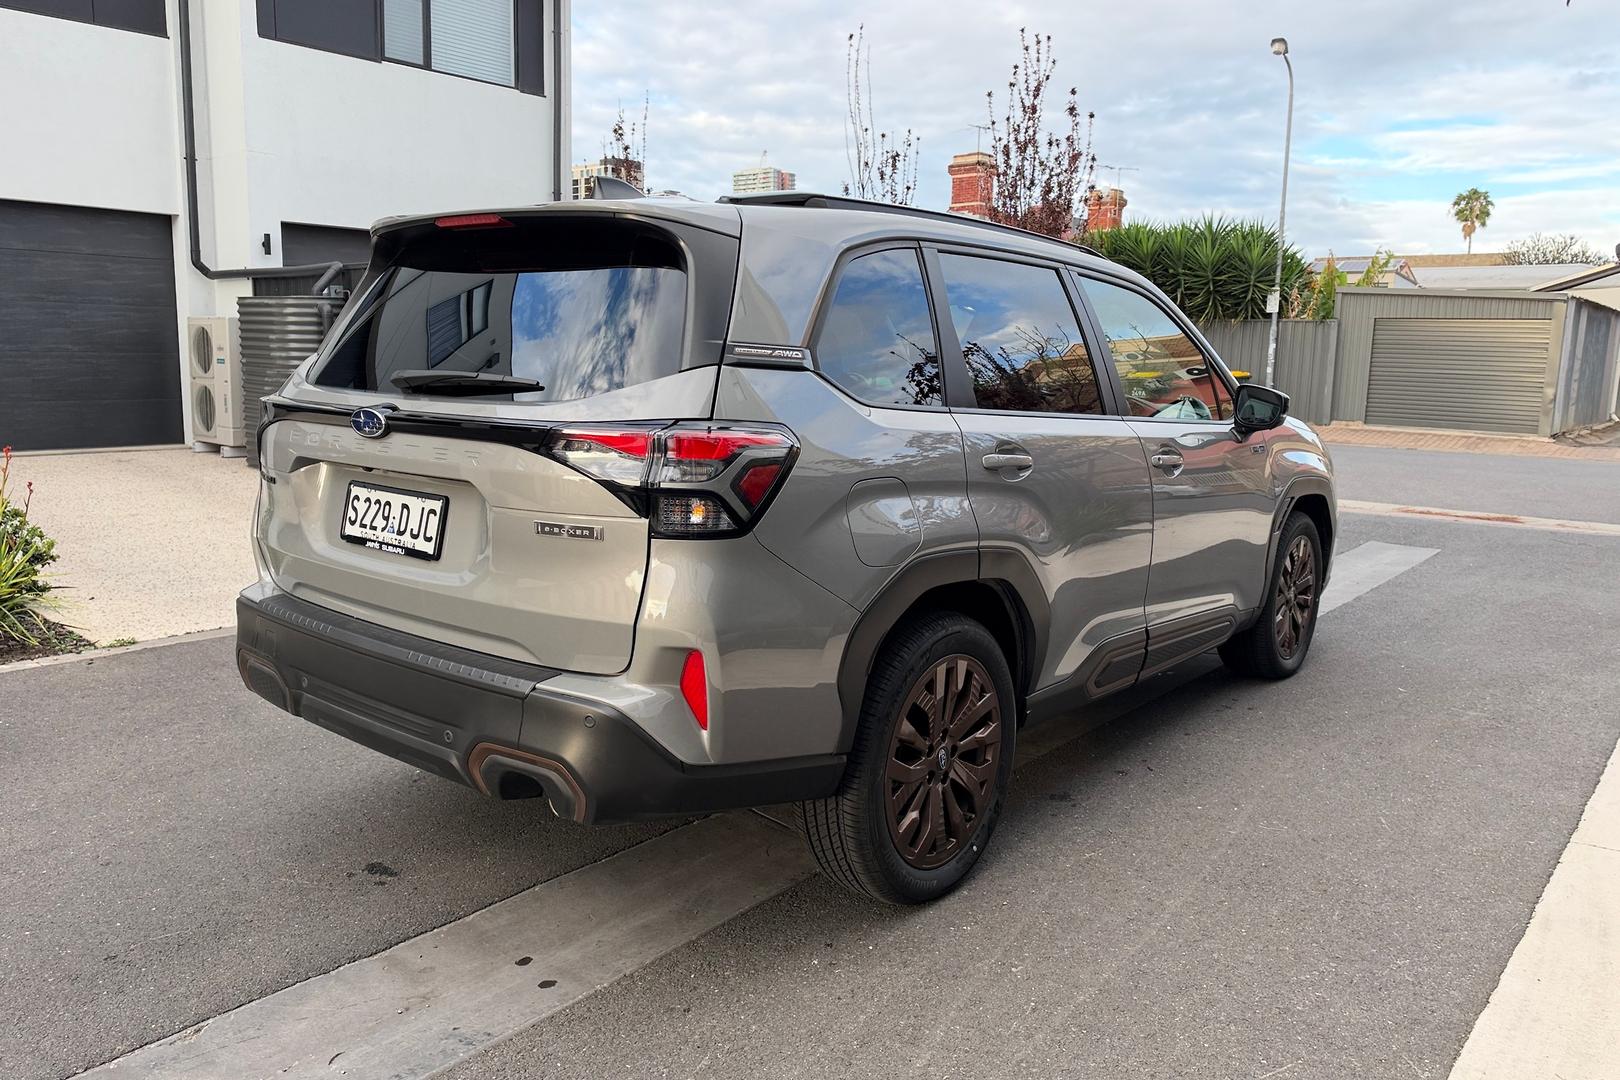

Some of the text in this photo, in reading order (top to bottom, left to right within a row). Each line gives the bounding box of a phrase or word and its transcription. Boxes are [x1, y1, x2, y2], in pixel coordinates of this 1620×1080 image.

[772, 349, 803, 358] AWD
[289, 428, 482, 467] FORESTER
[381, 544, 405, 555] SUBARU
